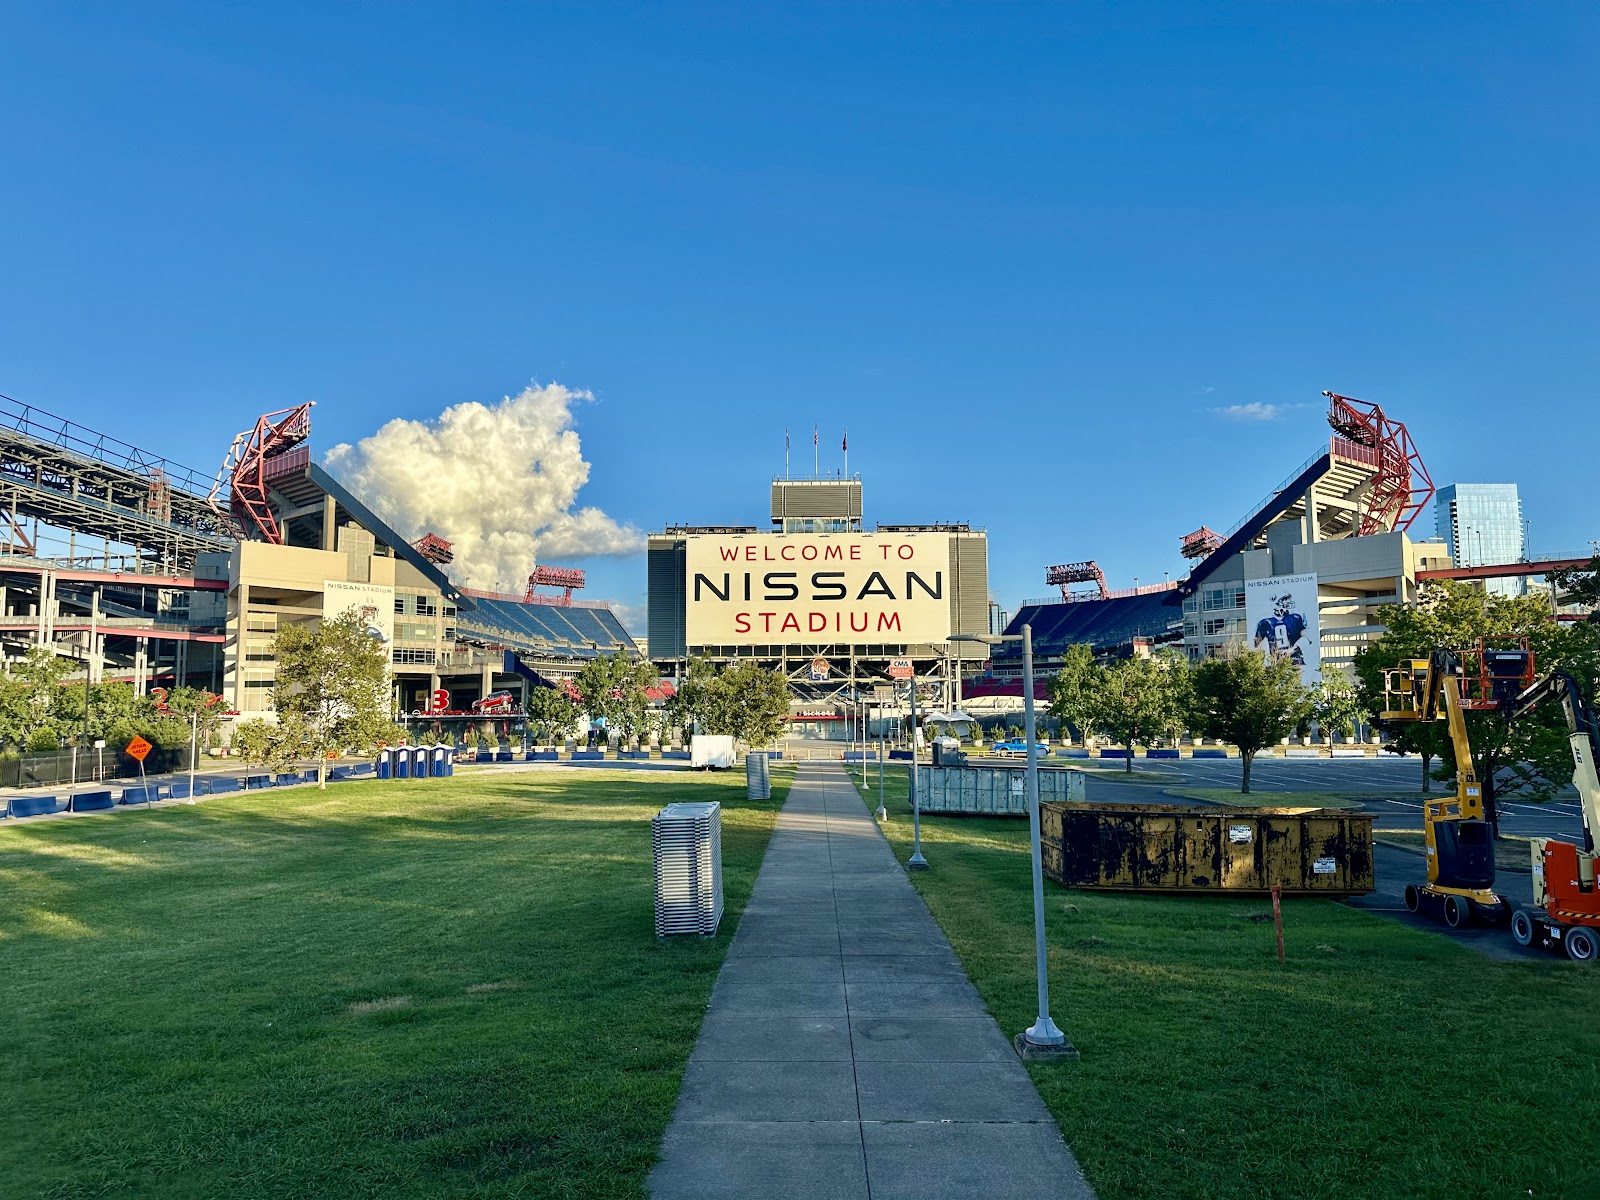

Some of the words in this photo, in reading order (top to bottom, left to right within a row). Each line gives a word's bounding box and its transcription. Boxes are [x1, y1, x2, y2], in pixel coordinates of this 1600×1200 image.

[720, 545, 861, 561] WELCOME
[878, 544, 914, 560] TO
[327, 583, 360, 591] NISSAN
[362, 586, 392, 594] STADIUM
[694, 571, 942, 602] NISSAN
[1247, 580, 1280, 588] NISSAN
[1281, 576, 1314, 585] STADIUM
[735, 612, 902, 633] STADIUM
[1274, 624, 1290, 648] 9
[432, 689, 450, 710] 3
[802, 709, 836, 717] tickets
